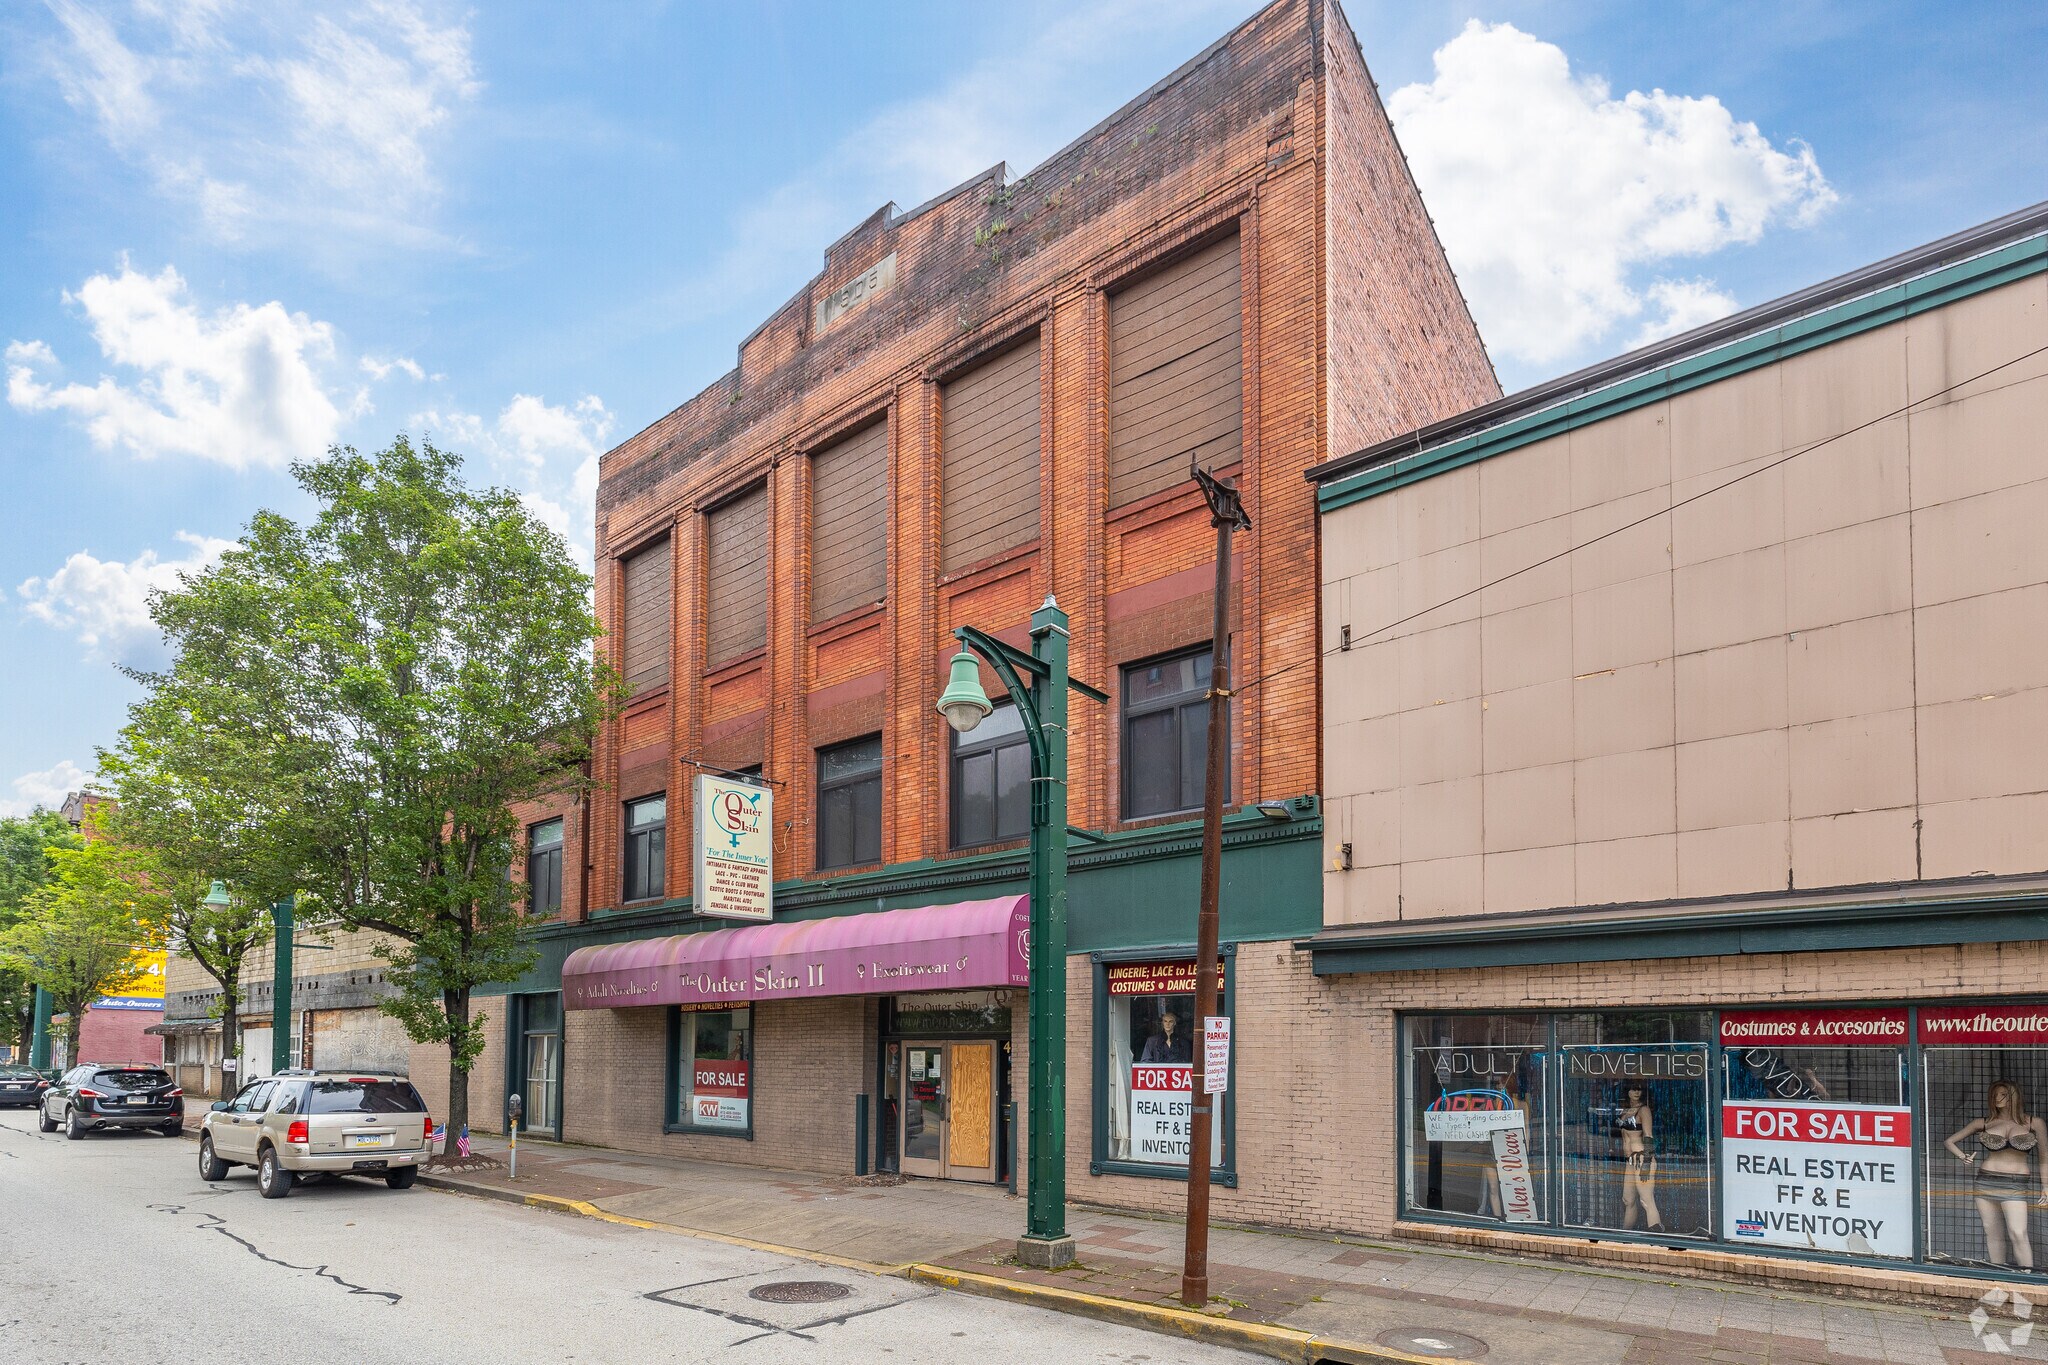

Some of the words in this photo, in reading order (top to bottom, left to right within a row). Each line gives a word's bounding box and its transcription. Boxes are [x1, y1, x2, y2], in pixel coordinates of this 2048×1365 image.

[725, 793, 762, 817] Outer
[728, 809, 759, 834] Skin
[722, 849, 735, 858] The
[735, 852, 752, 861] Inner
[706, 860, 727, 869] INTIMATE
[732, 864, 750, 873] FANTASY
[750, 867, 768, 875] APPAREL
[716, 878, 730, 886] DANCE
[746, 882, 759, 890] WEAR
[742, 874, 760, 882] LEATHER
[710, 885, 725, 893] EXOTIC
[725, 887, 739, 895] BOOTS
[743, 890, 765, 898] FOOTWEAR
[723, 895, 742, 903] MARITAL
[710, 902, 729, 910] SENSUAL
[1015, 913, 1030, 922] COST
[872, 961, 949, 979] Exoticwear
[1109, 967, 1150, 979] LINGERIE;
[1152, 965, 1174, 977] LACE
[1176, 967, 1185, 976] to
[680, 973, 697, 987] The
[697, 973, 747, 994] Outer
[754, 964, 800, 993] Skin
[807, 963, 825, 988] II
[587, 983, 608, 998] Adult
[610, 980, 648, 997] Novelties
[1111, 981, 1155, 993] COSTUMES
[98, 998, 162, 1008] Auto-Owners
[901, 1002, 920, 1013] The
[924, 1002, 951, 1012] Outer
[1215, 1021, 1222, 1029] NO
[1721, 1020, 1796, 1036] Costumes
[1800, 1022, 1810, 1036] &
[1813, 1016, 1905, 1036] Accesories
[1207, 1031, 1228, 1040] PARKING
[1434, 1052, 1522, 1075] ADULT
[1571, 1053, 1705, 1077] NOVELTIES
[696, 1071, 717, 1085] FOR
[718, 1072, 746, 1087] SALE
[1137, 1070, 1167, 1089] FOR
[1171, 1070, 1192, 1089] SA
[699, 1103, 718, 1116] KW
[1137, 1101, 1166, 1115] REAL
[1169, 1102, 1192, 1116] EST
[1449, 1114, 1459, 1123] Buy
[1463, 1114, 1486, 1123] Trading
[1156, 1121, 1169, 1134] FF
[1173, 1121, 1181, 1135] &
[1736, 1110, 1799, 1138] FOR
[1808, 1112, 1895, 1143] SALE
[1444, 1131, 1463, 1139] NEED
[1466, 1131, 1489, 1139] CASH?
[1142, 1139, 1191, 1155] INVENTO
[1500, 1132, 1523, 1171] Wear
[1736, 1154, 1797, 1177] REAL
[1804, 1158, 1896, 1183] ESTATE
[1505, 1176, 1531, 1219] Men's
[1777, 1184, 1804, 1204] FF
[1812, 1187, 1828, 1207] &
[1836, 1188, 1851, 1209] E
[1748, 1209, 1884, 1240] INVENTORY
